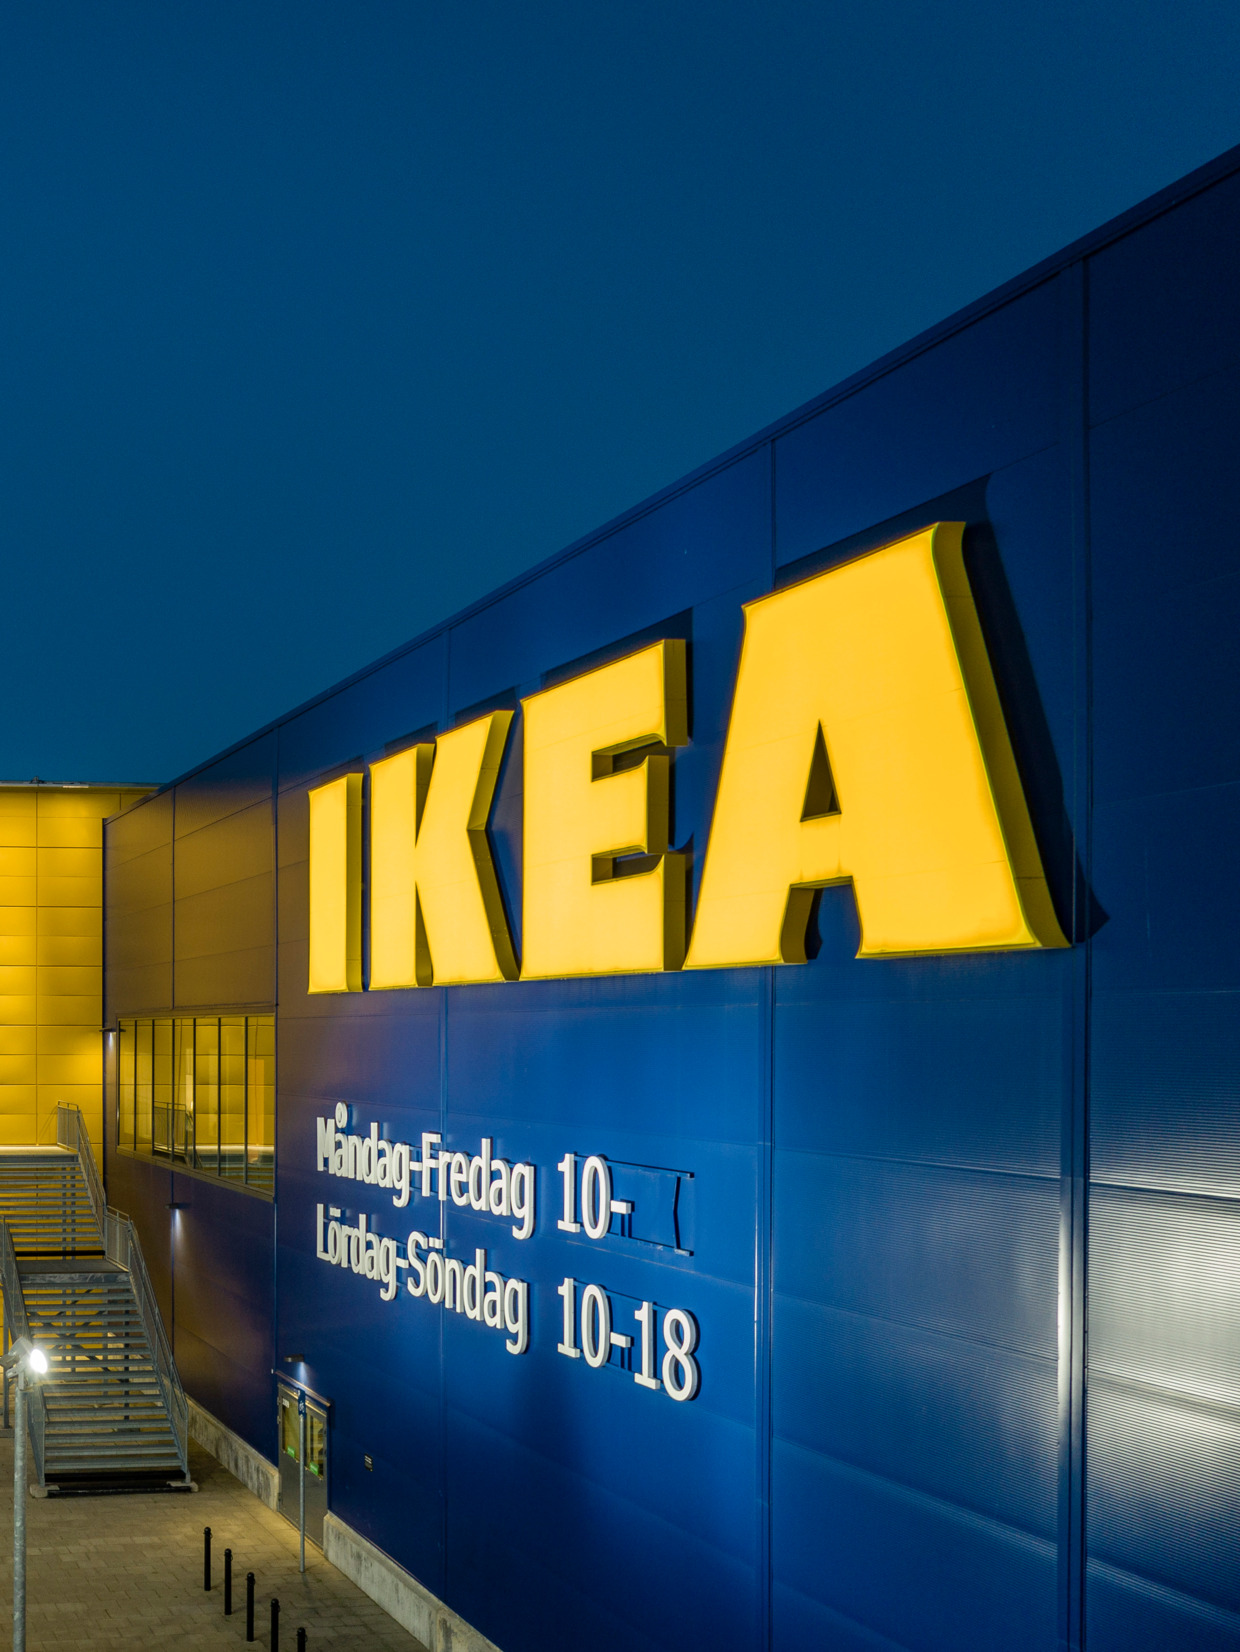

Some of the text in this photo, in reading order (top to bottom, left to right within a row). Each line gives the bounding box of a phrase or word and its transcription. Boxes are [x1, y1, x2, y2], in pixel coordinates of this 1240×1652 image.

[307, 520, 1073, 995] IKEA
[316, 1101, 632, 1240] Måndag-Fredag 10-
[316, 1204, 697, 1401] Lördag-Söndag 10-18
